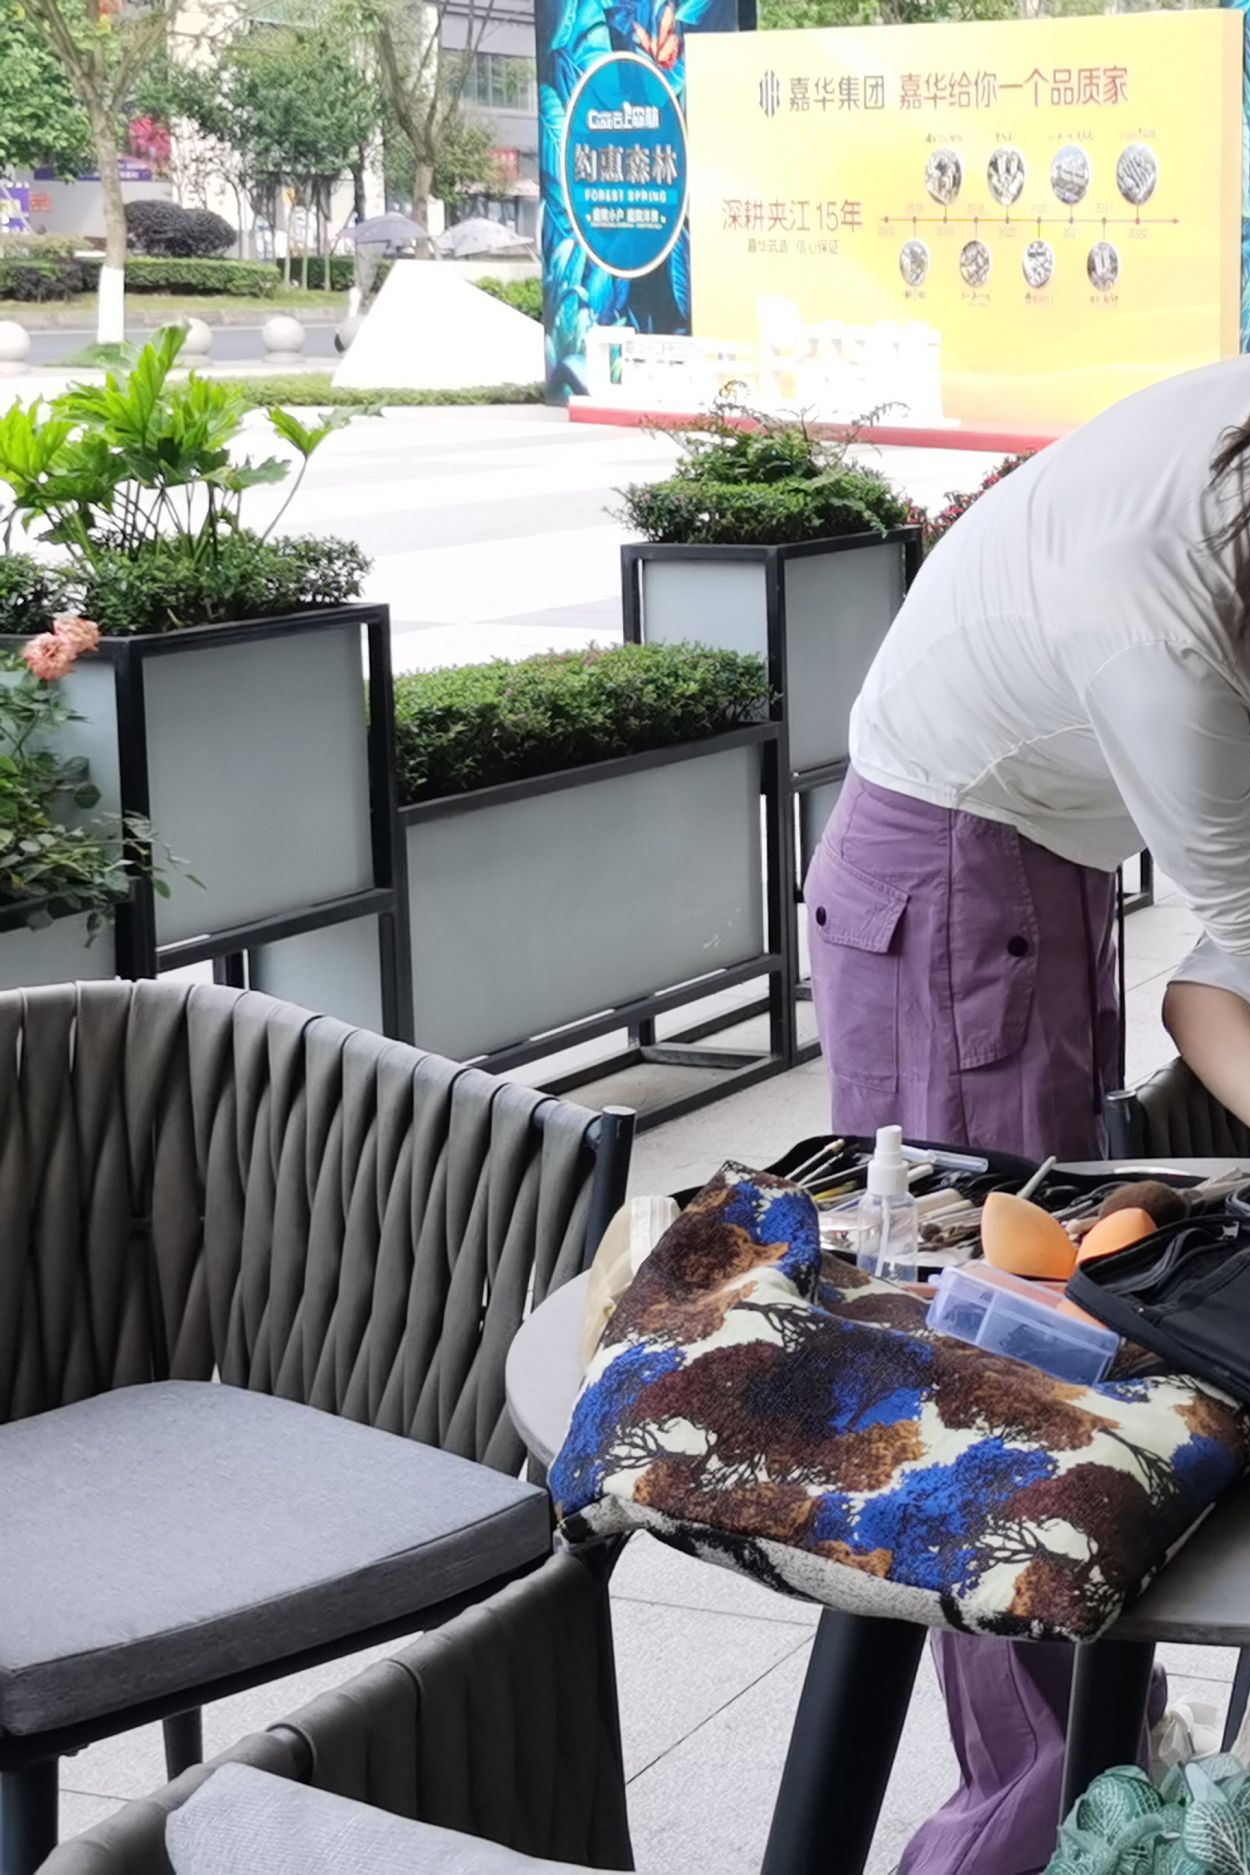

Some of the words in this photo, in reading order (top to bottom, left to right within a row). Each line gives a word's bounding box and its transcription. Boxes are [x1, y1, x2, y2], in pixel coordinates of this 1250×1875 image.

[789, 75, 884, 112] 嘉华集团
[900, 66, 1128, 110] 嘉华给你一个品质家
[575, 143, 678, 185] 约惠森林
[722, 199, 862, 232] 深耕夹江15年
